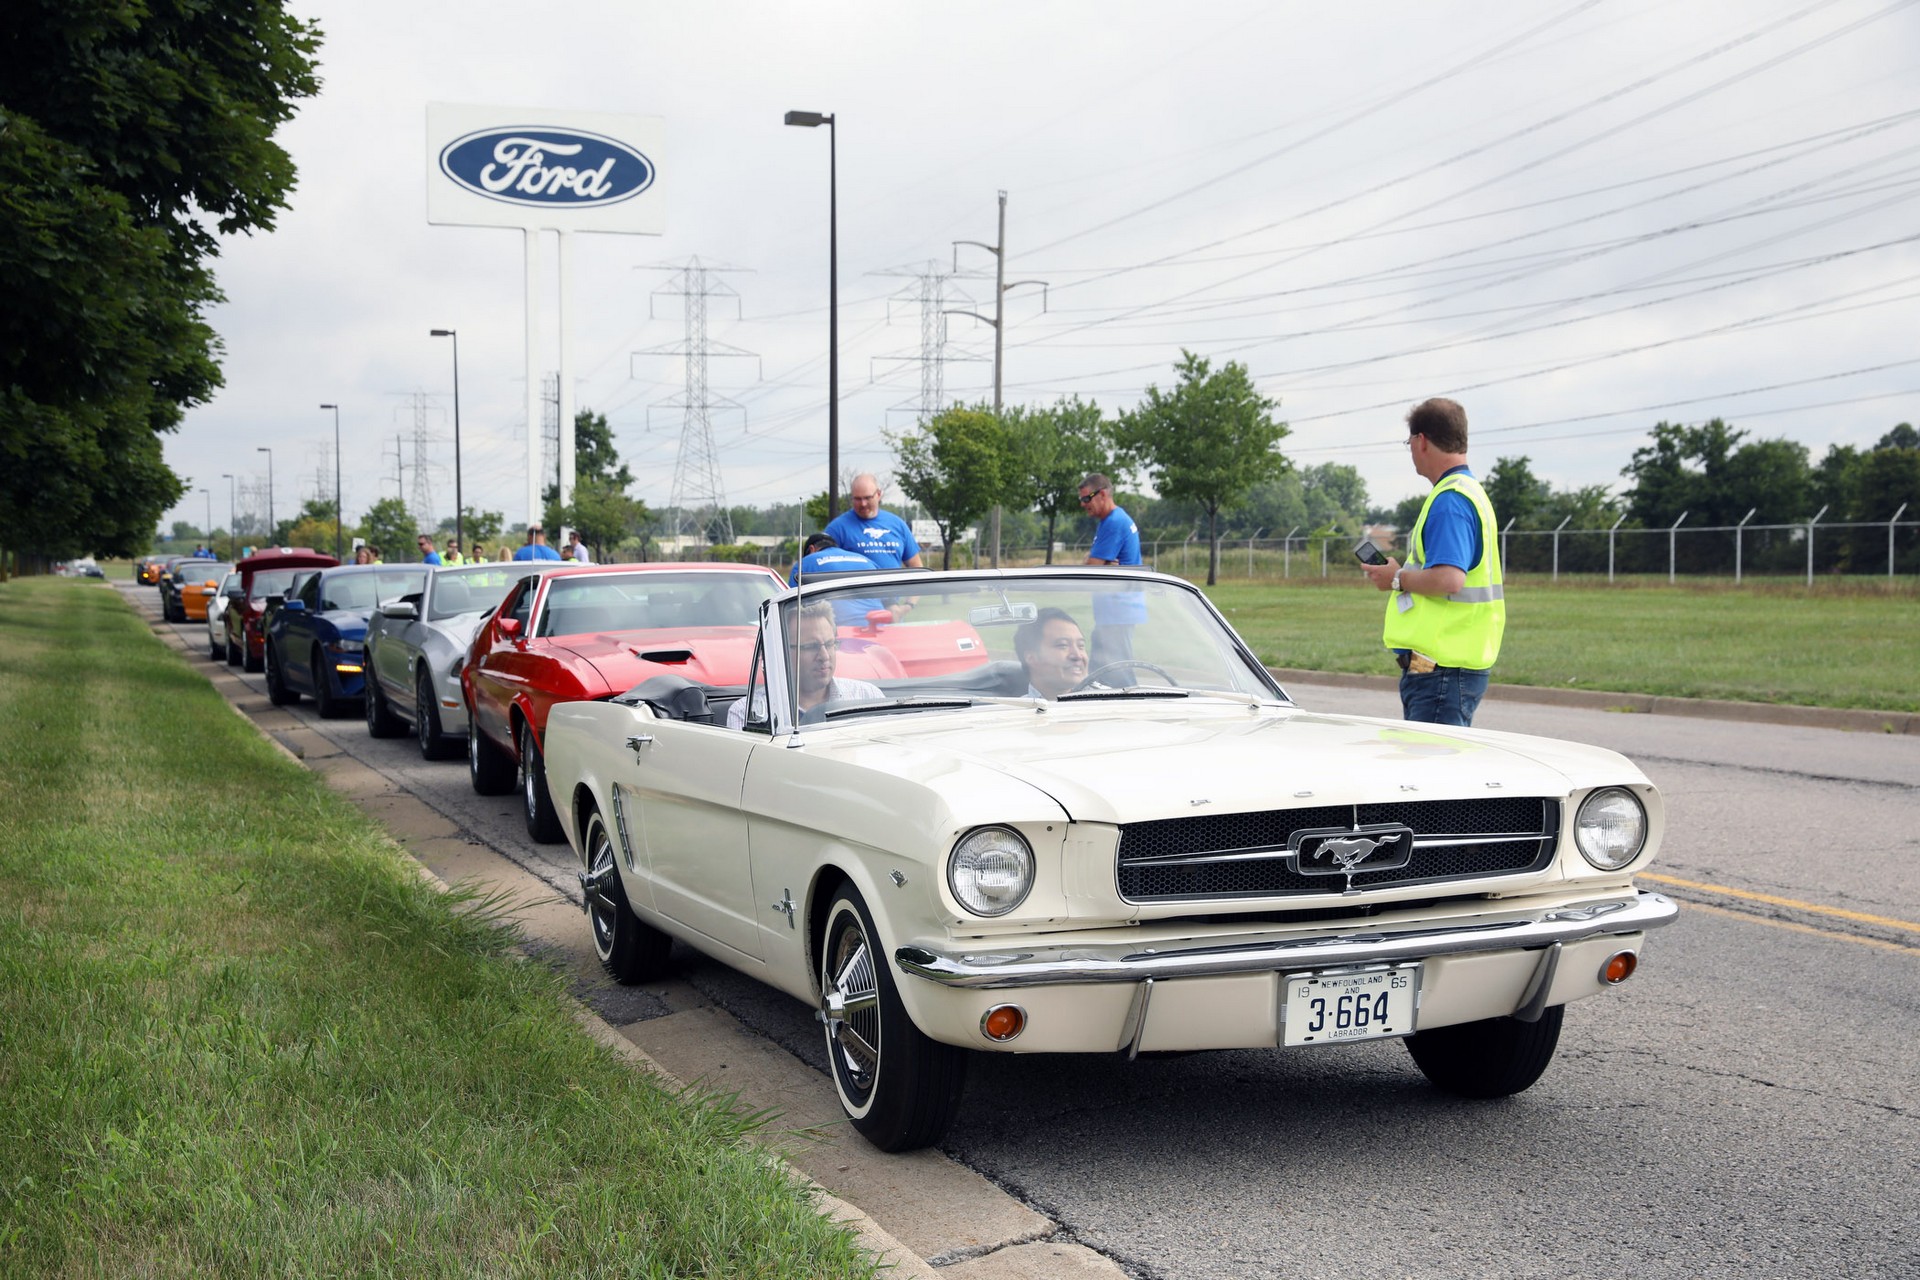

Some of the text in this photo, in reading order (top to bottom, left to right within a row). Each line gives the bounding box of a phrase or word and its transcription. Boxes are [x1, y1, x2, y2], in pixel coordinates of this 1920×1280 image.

[480, 137, 616, 198] Ford
[1321, 975, 1383, 989] NEWFOUNDLAND
[1391, 976, 1407, 989] 65
[1298, 986, 1310, 998] 19
[1344, 986, 1360, 995] AND
[1328, 1027, 1368, 1039] LABRADOR
